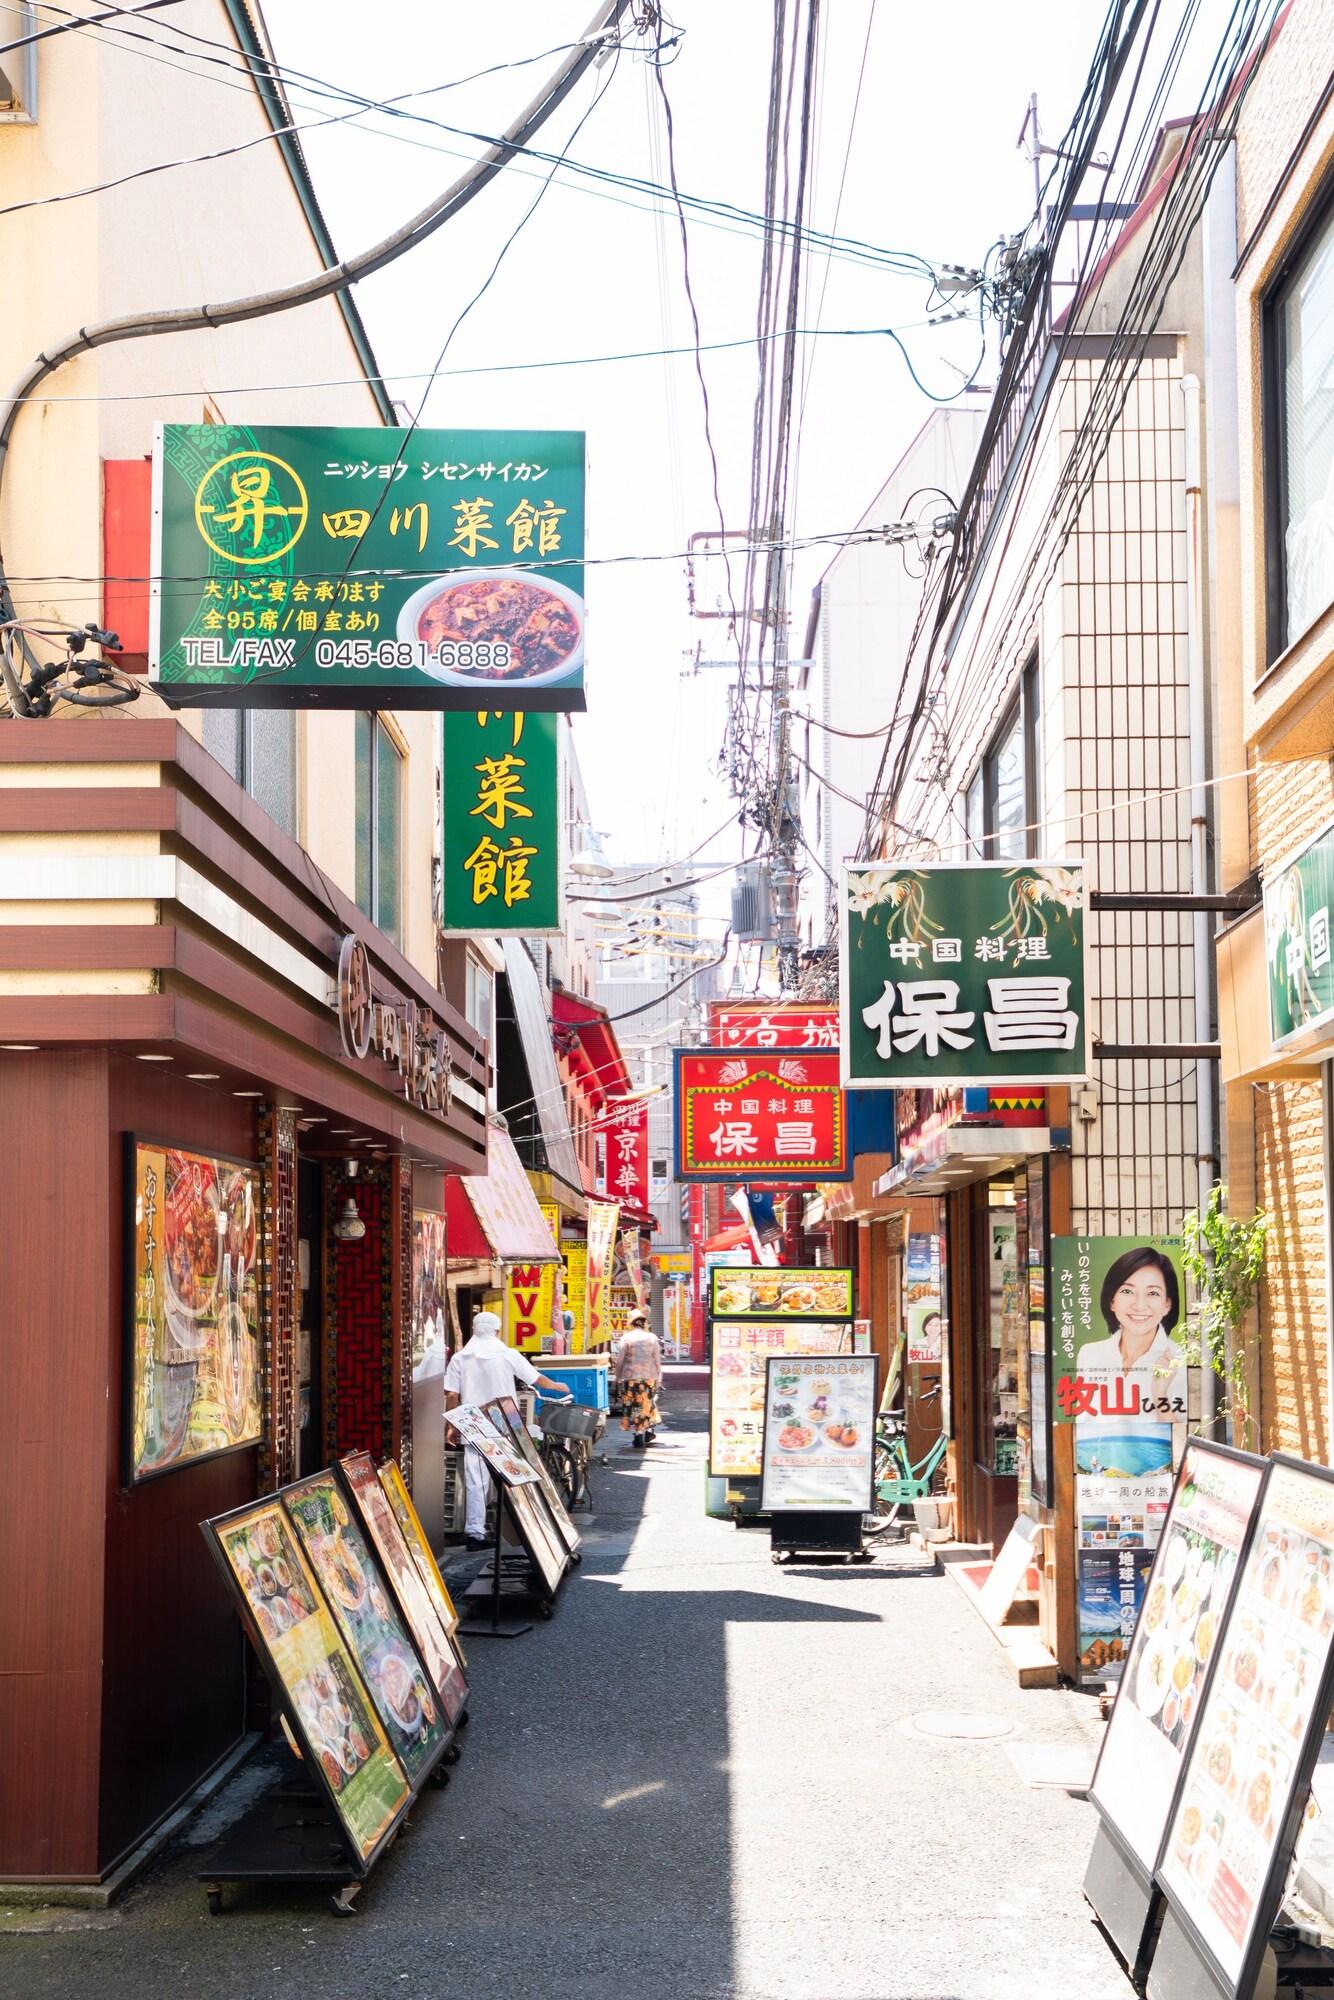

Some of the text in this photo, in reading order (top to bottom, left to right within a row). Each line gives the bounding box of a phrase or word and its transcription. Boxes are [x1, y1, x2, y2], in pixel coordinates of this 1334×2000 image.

[323, 461, 549, 482] ニッショウ シセンサイカン
[321, 496, 568, 558] 四川菜館
[203, 580, 385, 602] 大小ご宴会承ります
[182, 639, 511, 669] TEL/FAX 045-681-6888
[862, 976, 1080, 1060] 保昌
[713, 1098, 815, 1116] 中国料理
[709, 1121, 817, 1157] 保昌
[1078, 1242, 1092, 1330] いのちを守る、
[1061, 1269, 1075, 1359] みらいを創る。
[1056, 1375, 1187, 1417] 牧山 ひろえ
